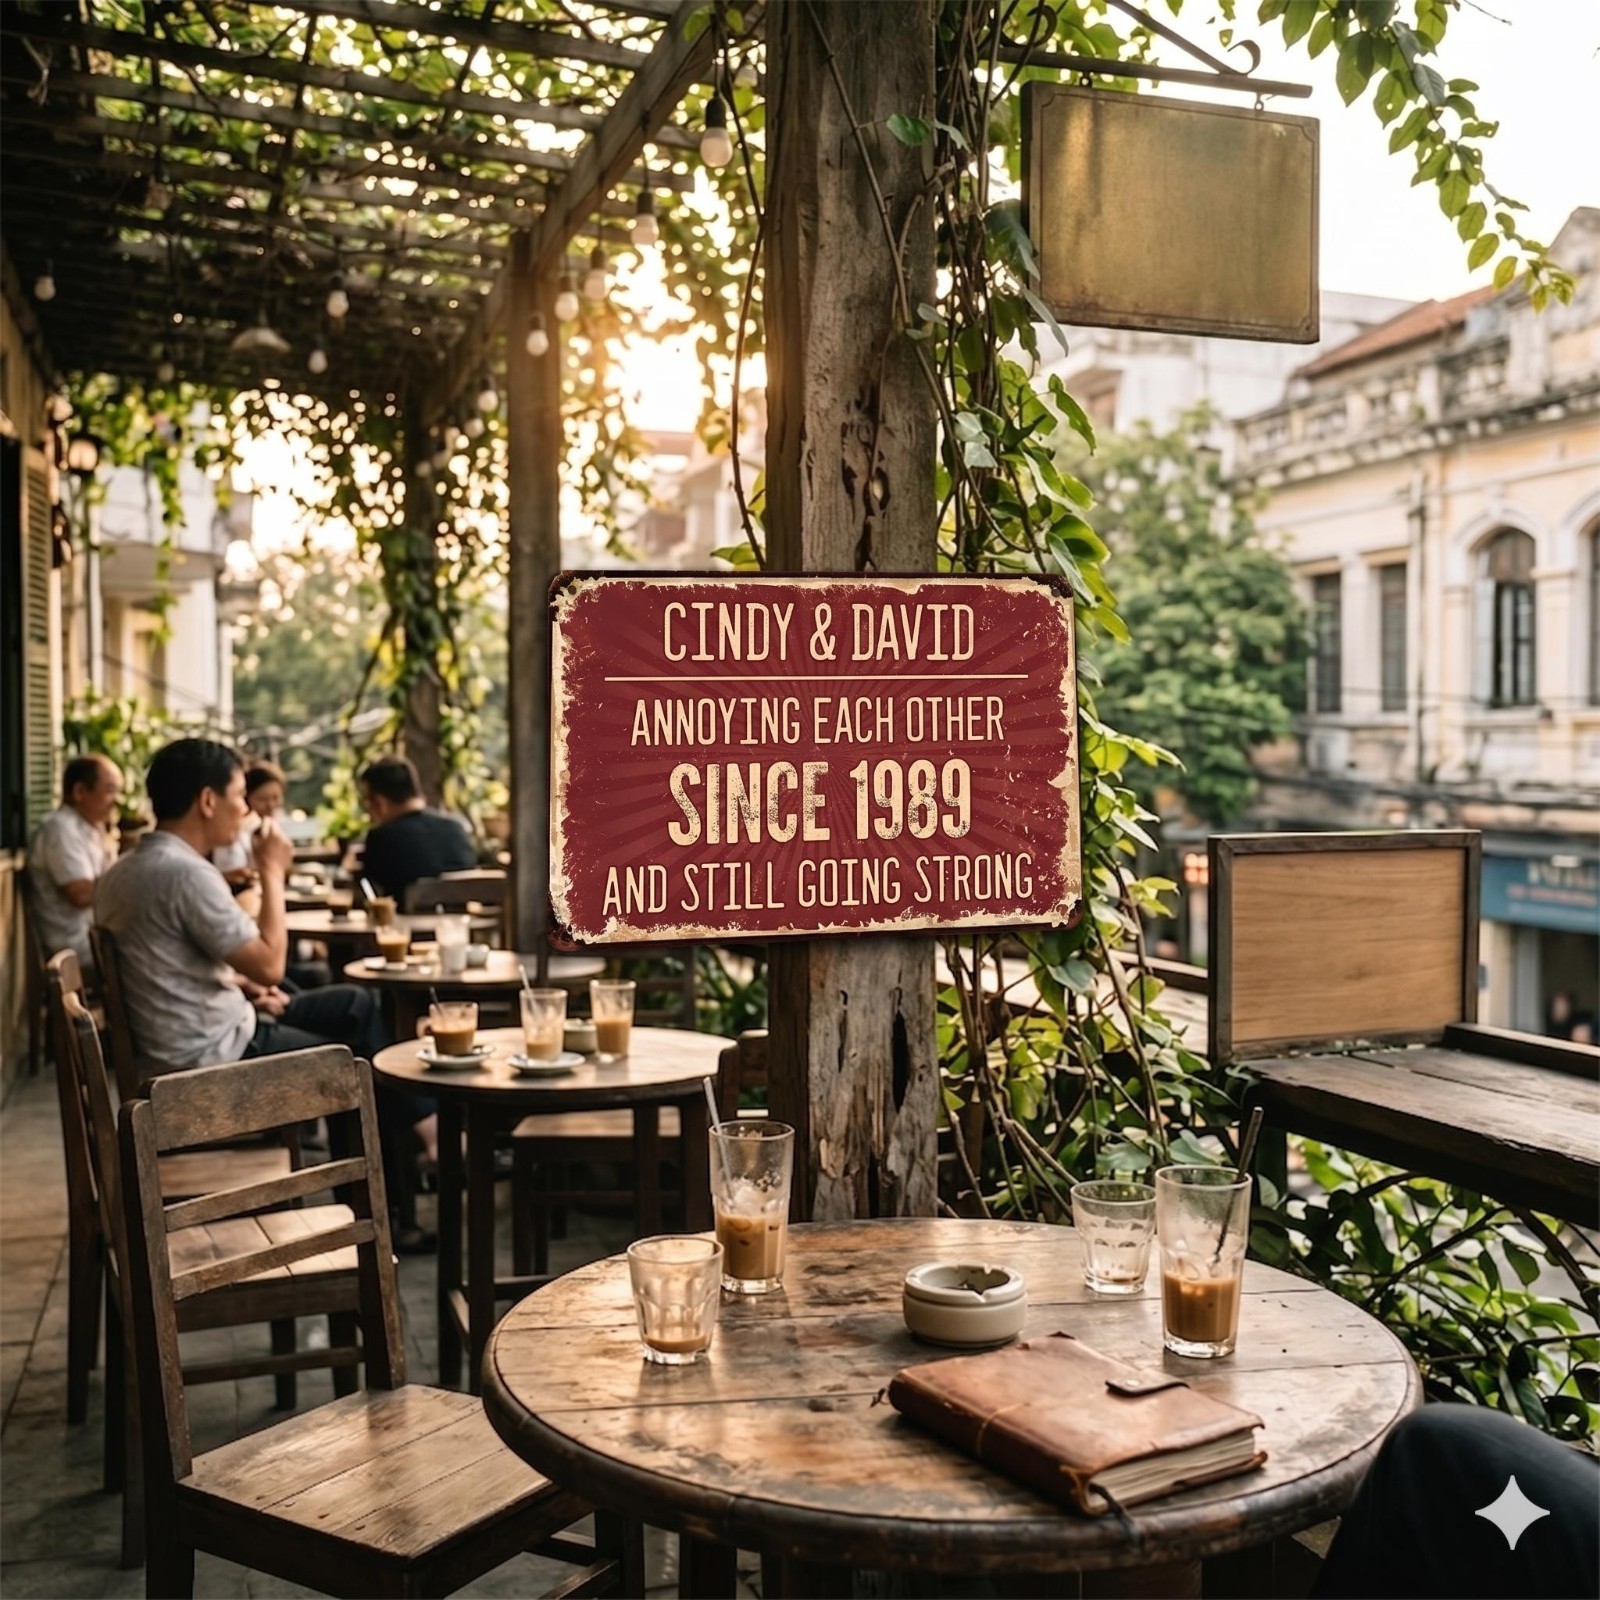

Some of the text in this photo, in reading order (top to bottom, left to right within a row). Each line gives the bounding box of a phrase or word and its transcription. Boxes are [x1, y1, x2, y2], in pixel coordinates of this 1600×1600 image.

[664, 602, 975, 662] CINDY & DAVID
[631, 695, 1005, 746] ANNOYING EACH OTHER
[667, 758, 972, 846] SINCE 1989
[602, 852, 1034, 916] AND STILL GOING STRONG
